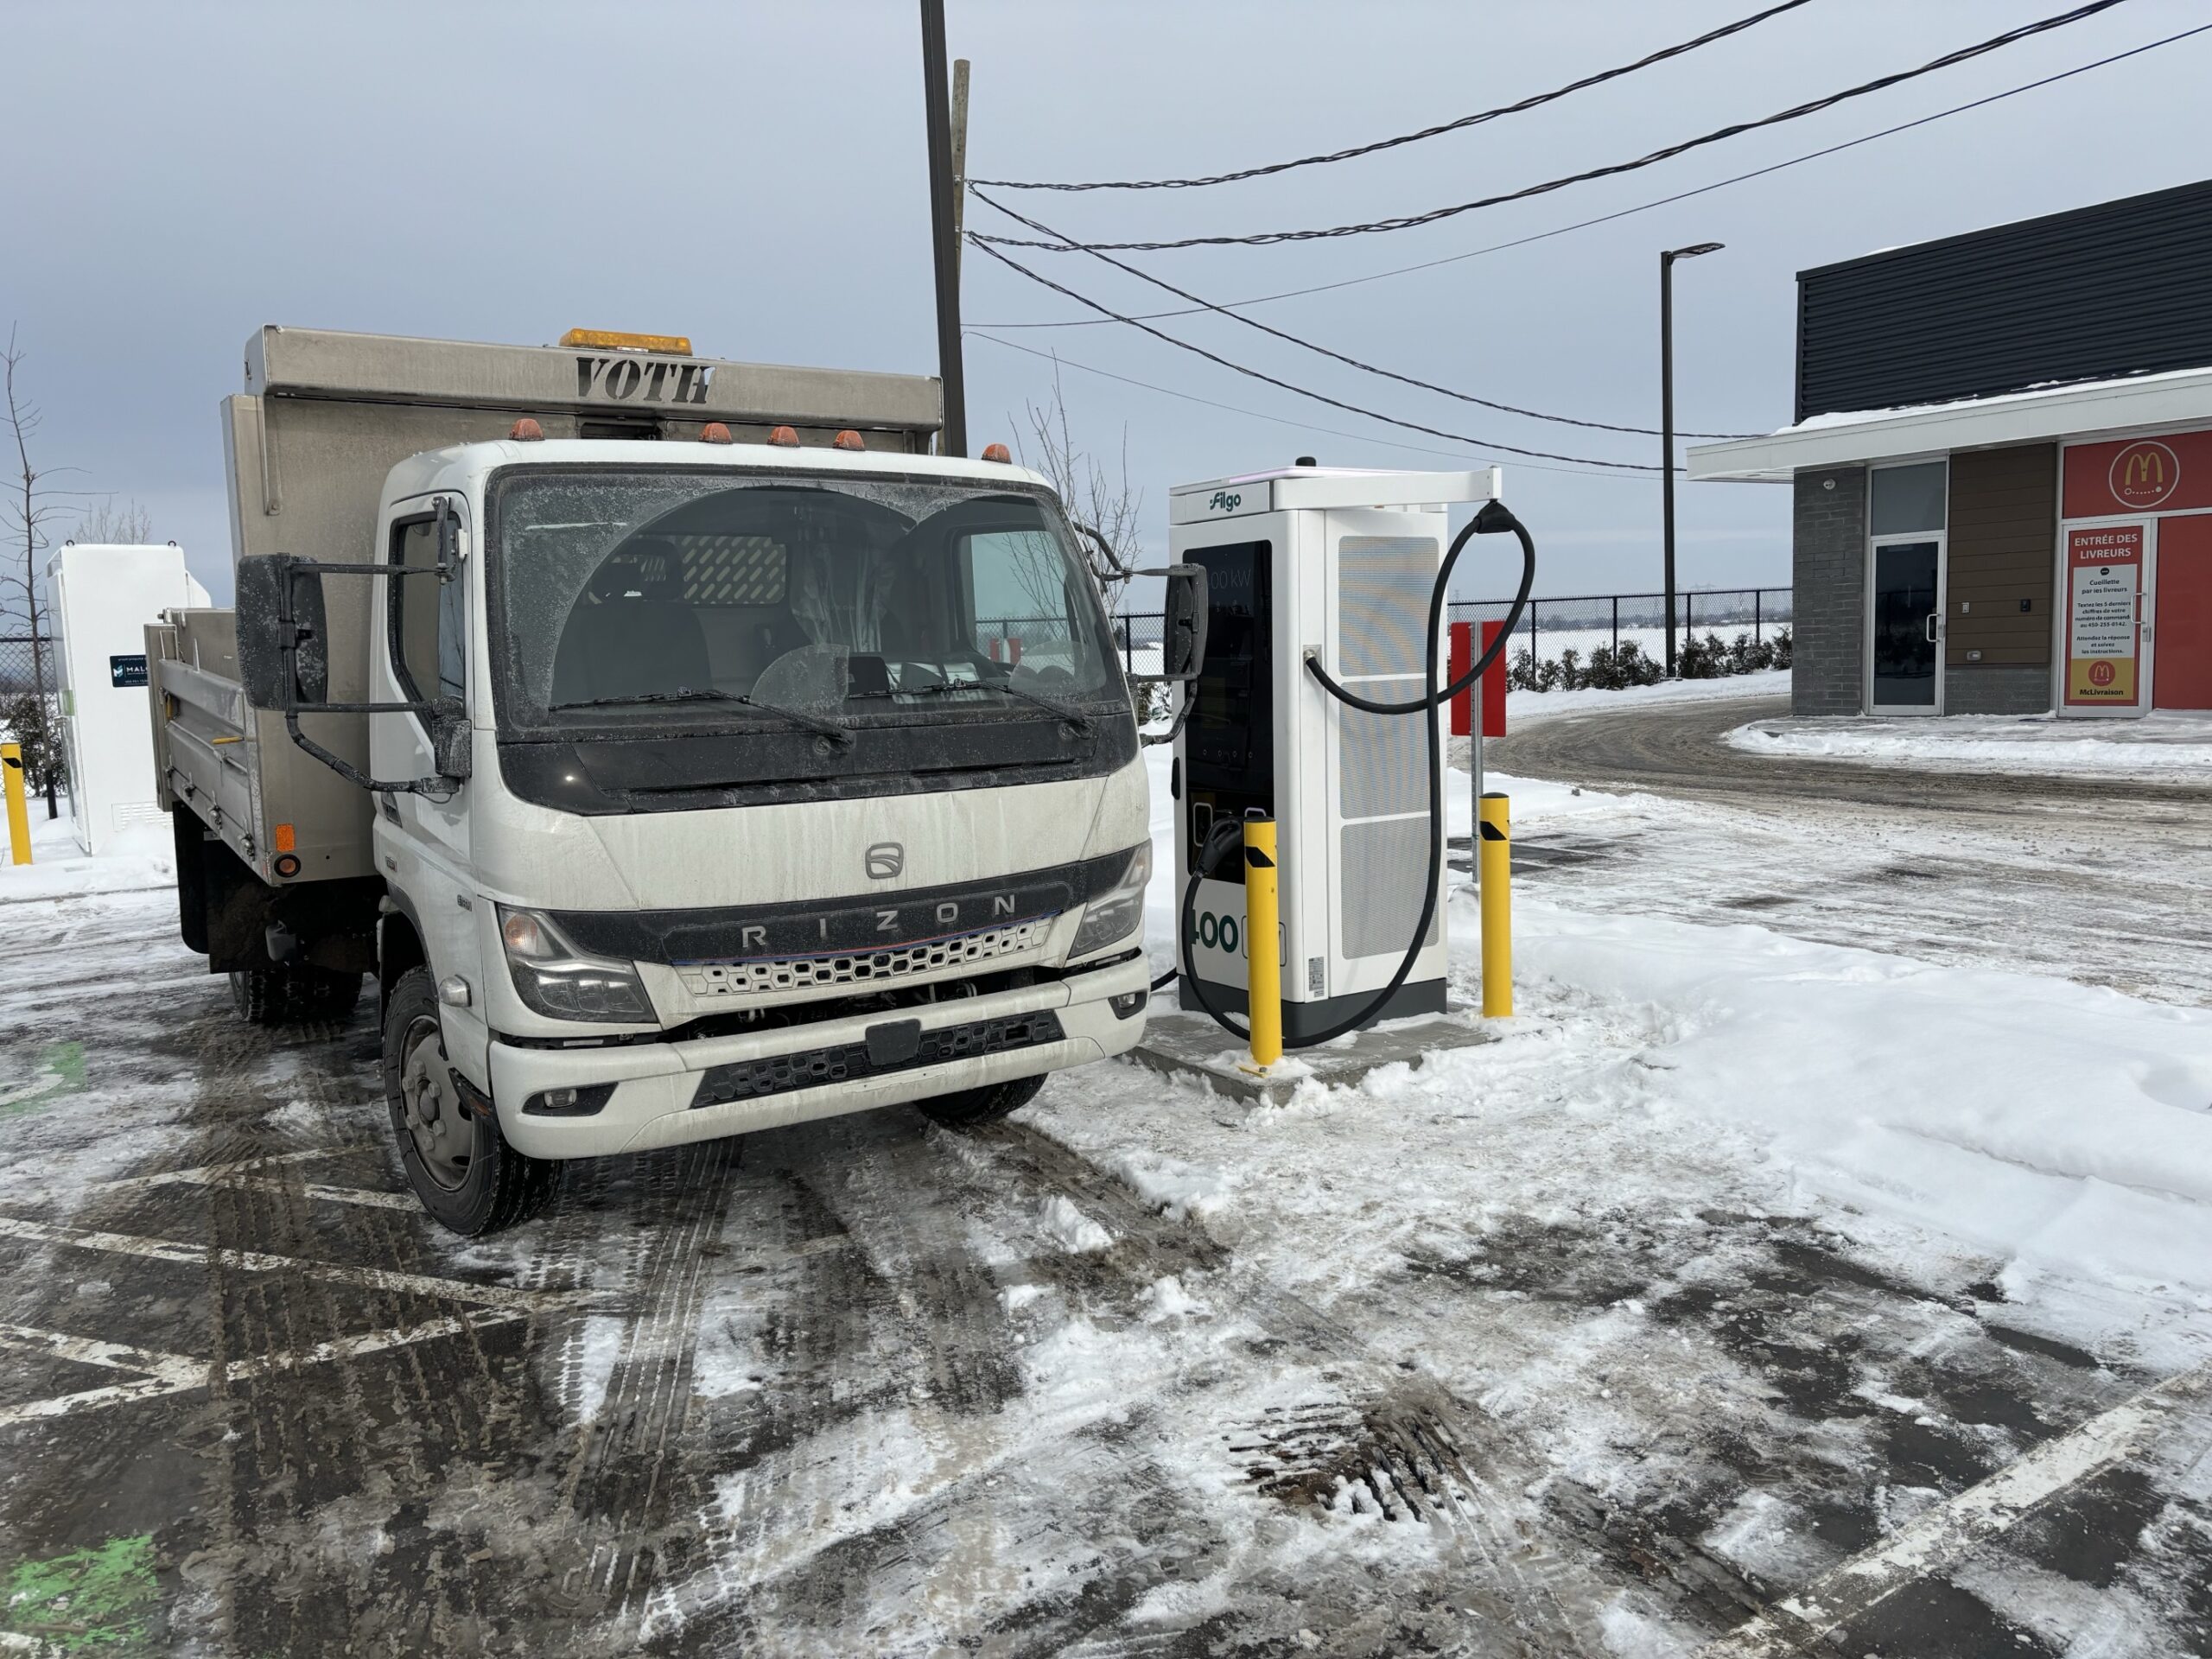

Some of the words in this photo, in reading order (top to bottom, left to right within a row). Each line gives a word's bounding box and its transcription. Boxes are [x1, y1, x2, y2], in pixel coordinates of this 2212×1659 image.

[576, 357, 716, 404] VOTH
[2074, 534, 2114, 546] ENTRÉE
[2116, 533, 2138, 543] DES
[2080, 547, 2132, 559] LIVREURS
[741, 894, 1015, 948] RIZON
